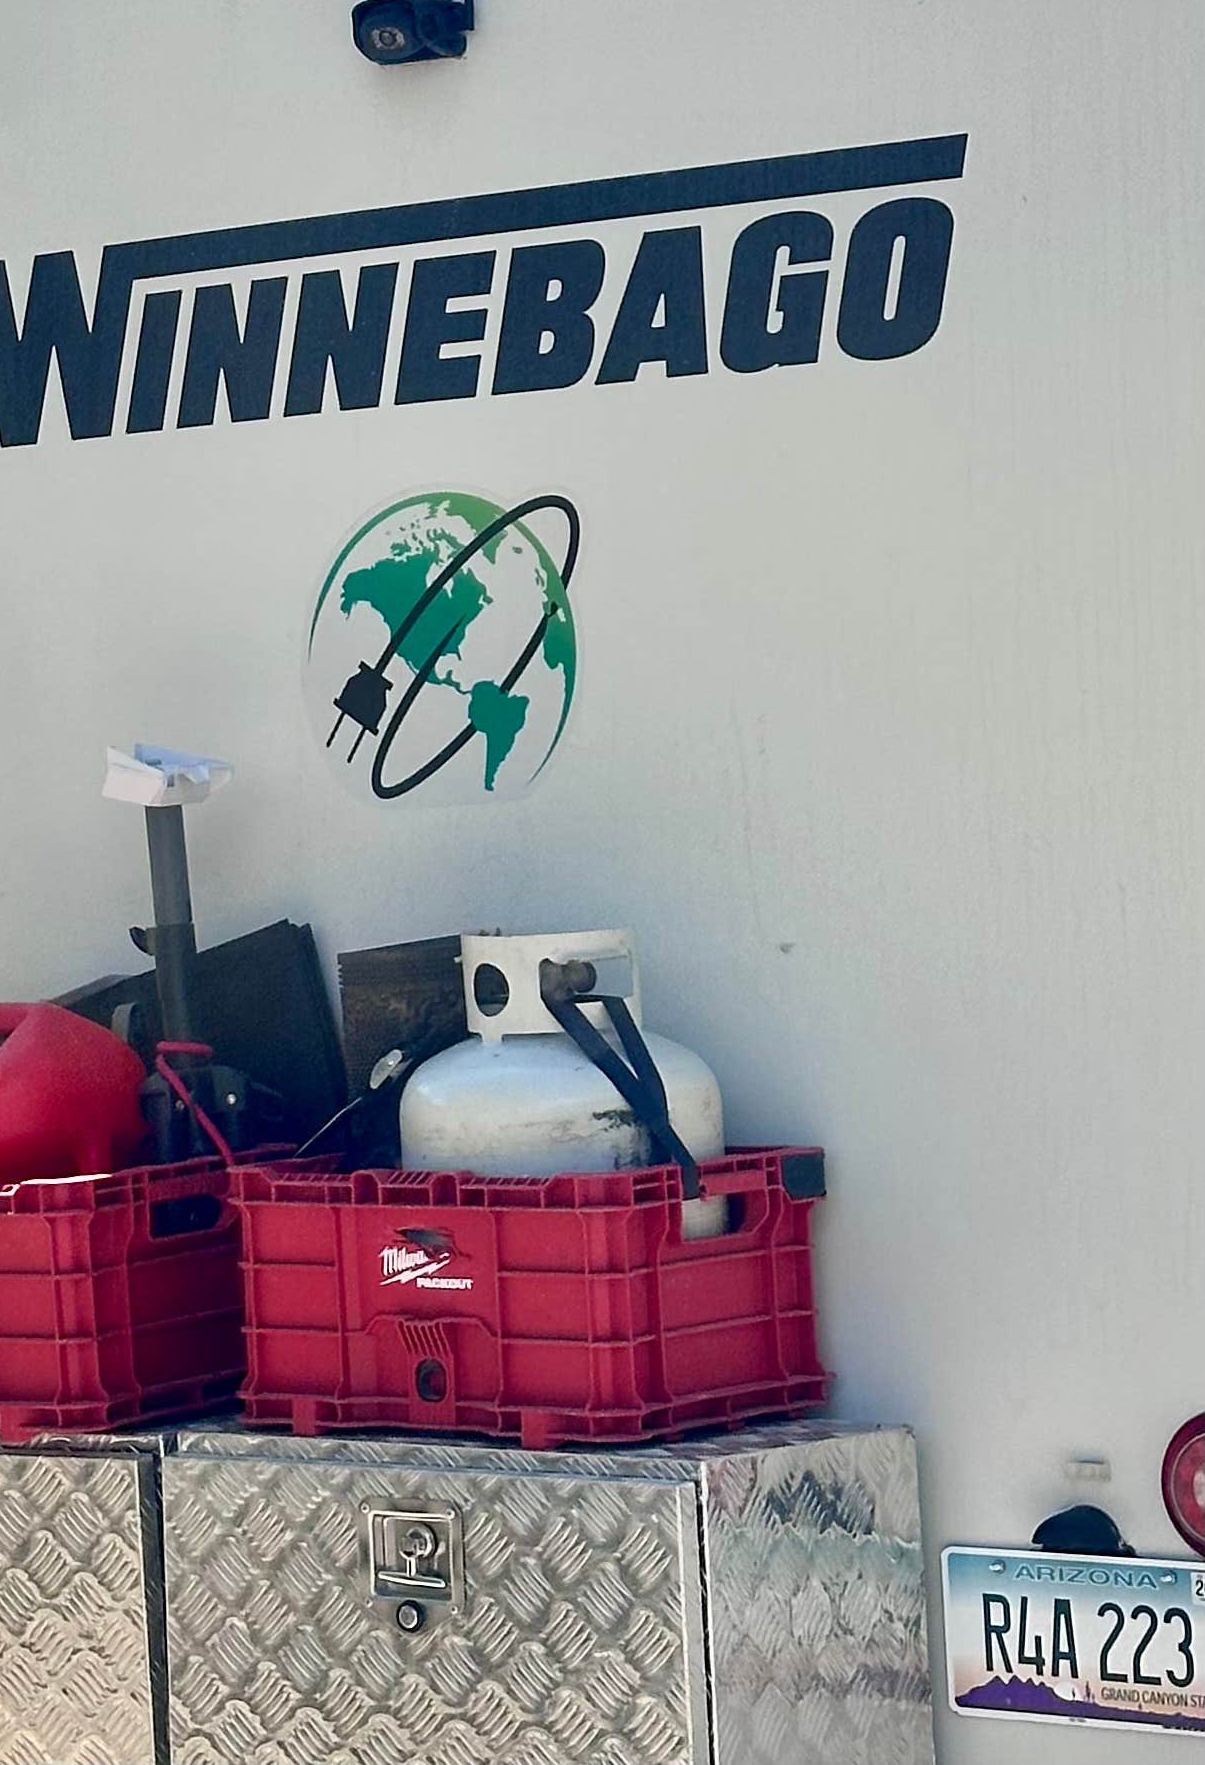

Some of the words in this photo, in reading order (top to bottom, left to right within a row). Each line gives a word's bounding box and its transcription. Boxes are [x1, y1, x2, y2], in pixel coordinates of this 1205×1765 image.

[1014, 1563, 1158, 1589] ARIZONA
[982, 1593, 1079, 1679] R4A
[1097, 1602, 1195, 1688] 223
[1101, 1687, 1140, 1703] GRAND
[1141, 1690, 1188, 1707] CANYON
